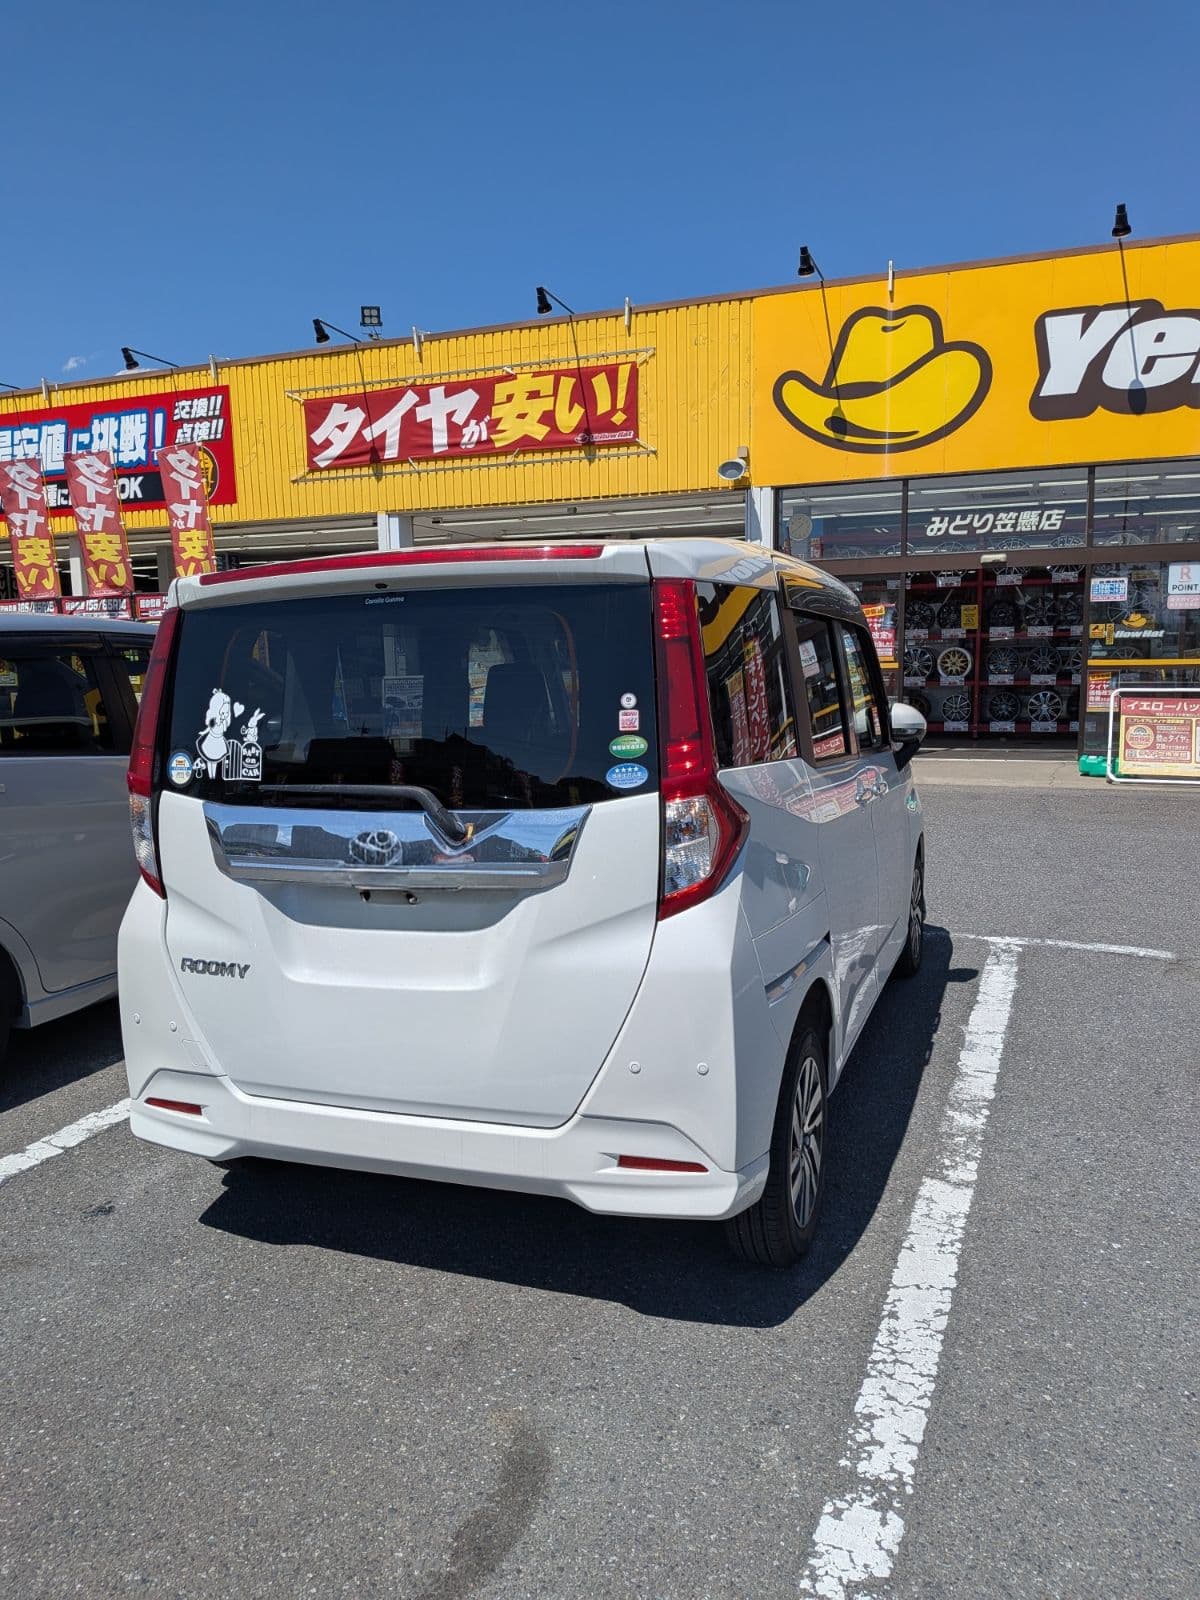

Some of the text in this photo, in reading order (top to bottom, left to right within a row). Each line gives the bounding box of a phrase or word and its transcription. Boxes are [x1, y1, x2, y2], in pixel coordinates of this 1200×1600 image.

[1037, 305, 1200, 398] Ye
[310, 363, 632, 469] タイヤが安い!
[926, 509, 1065, 537] みどり笠懸店
[1171, 583, 1200, 592] POINT
[242, 768, 260, 777] CAR
[180, 957, 251, 979] ROOMY
